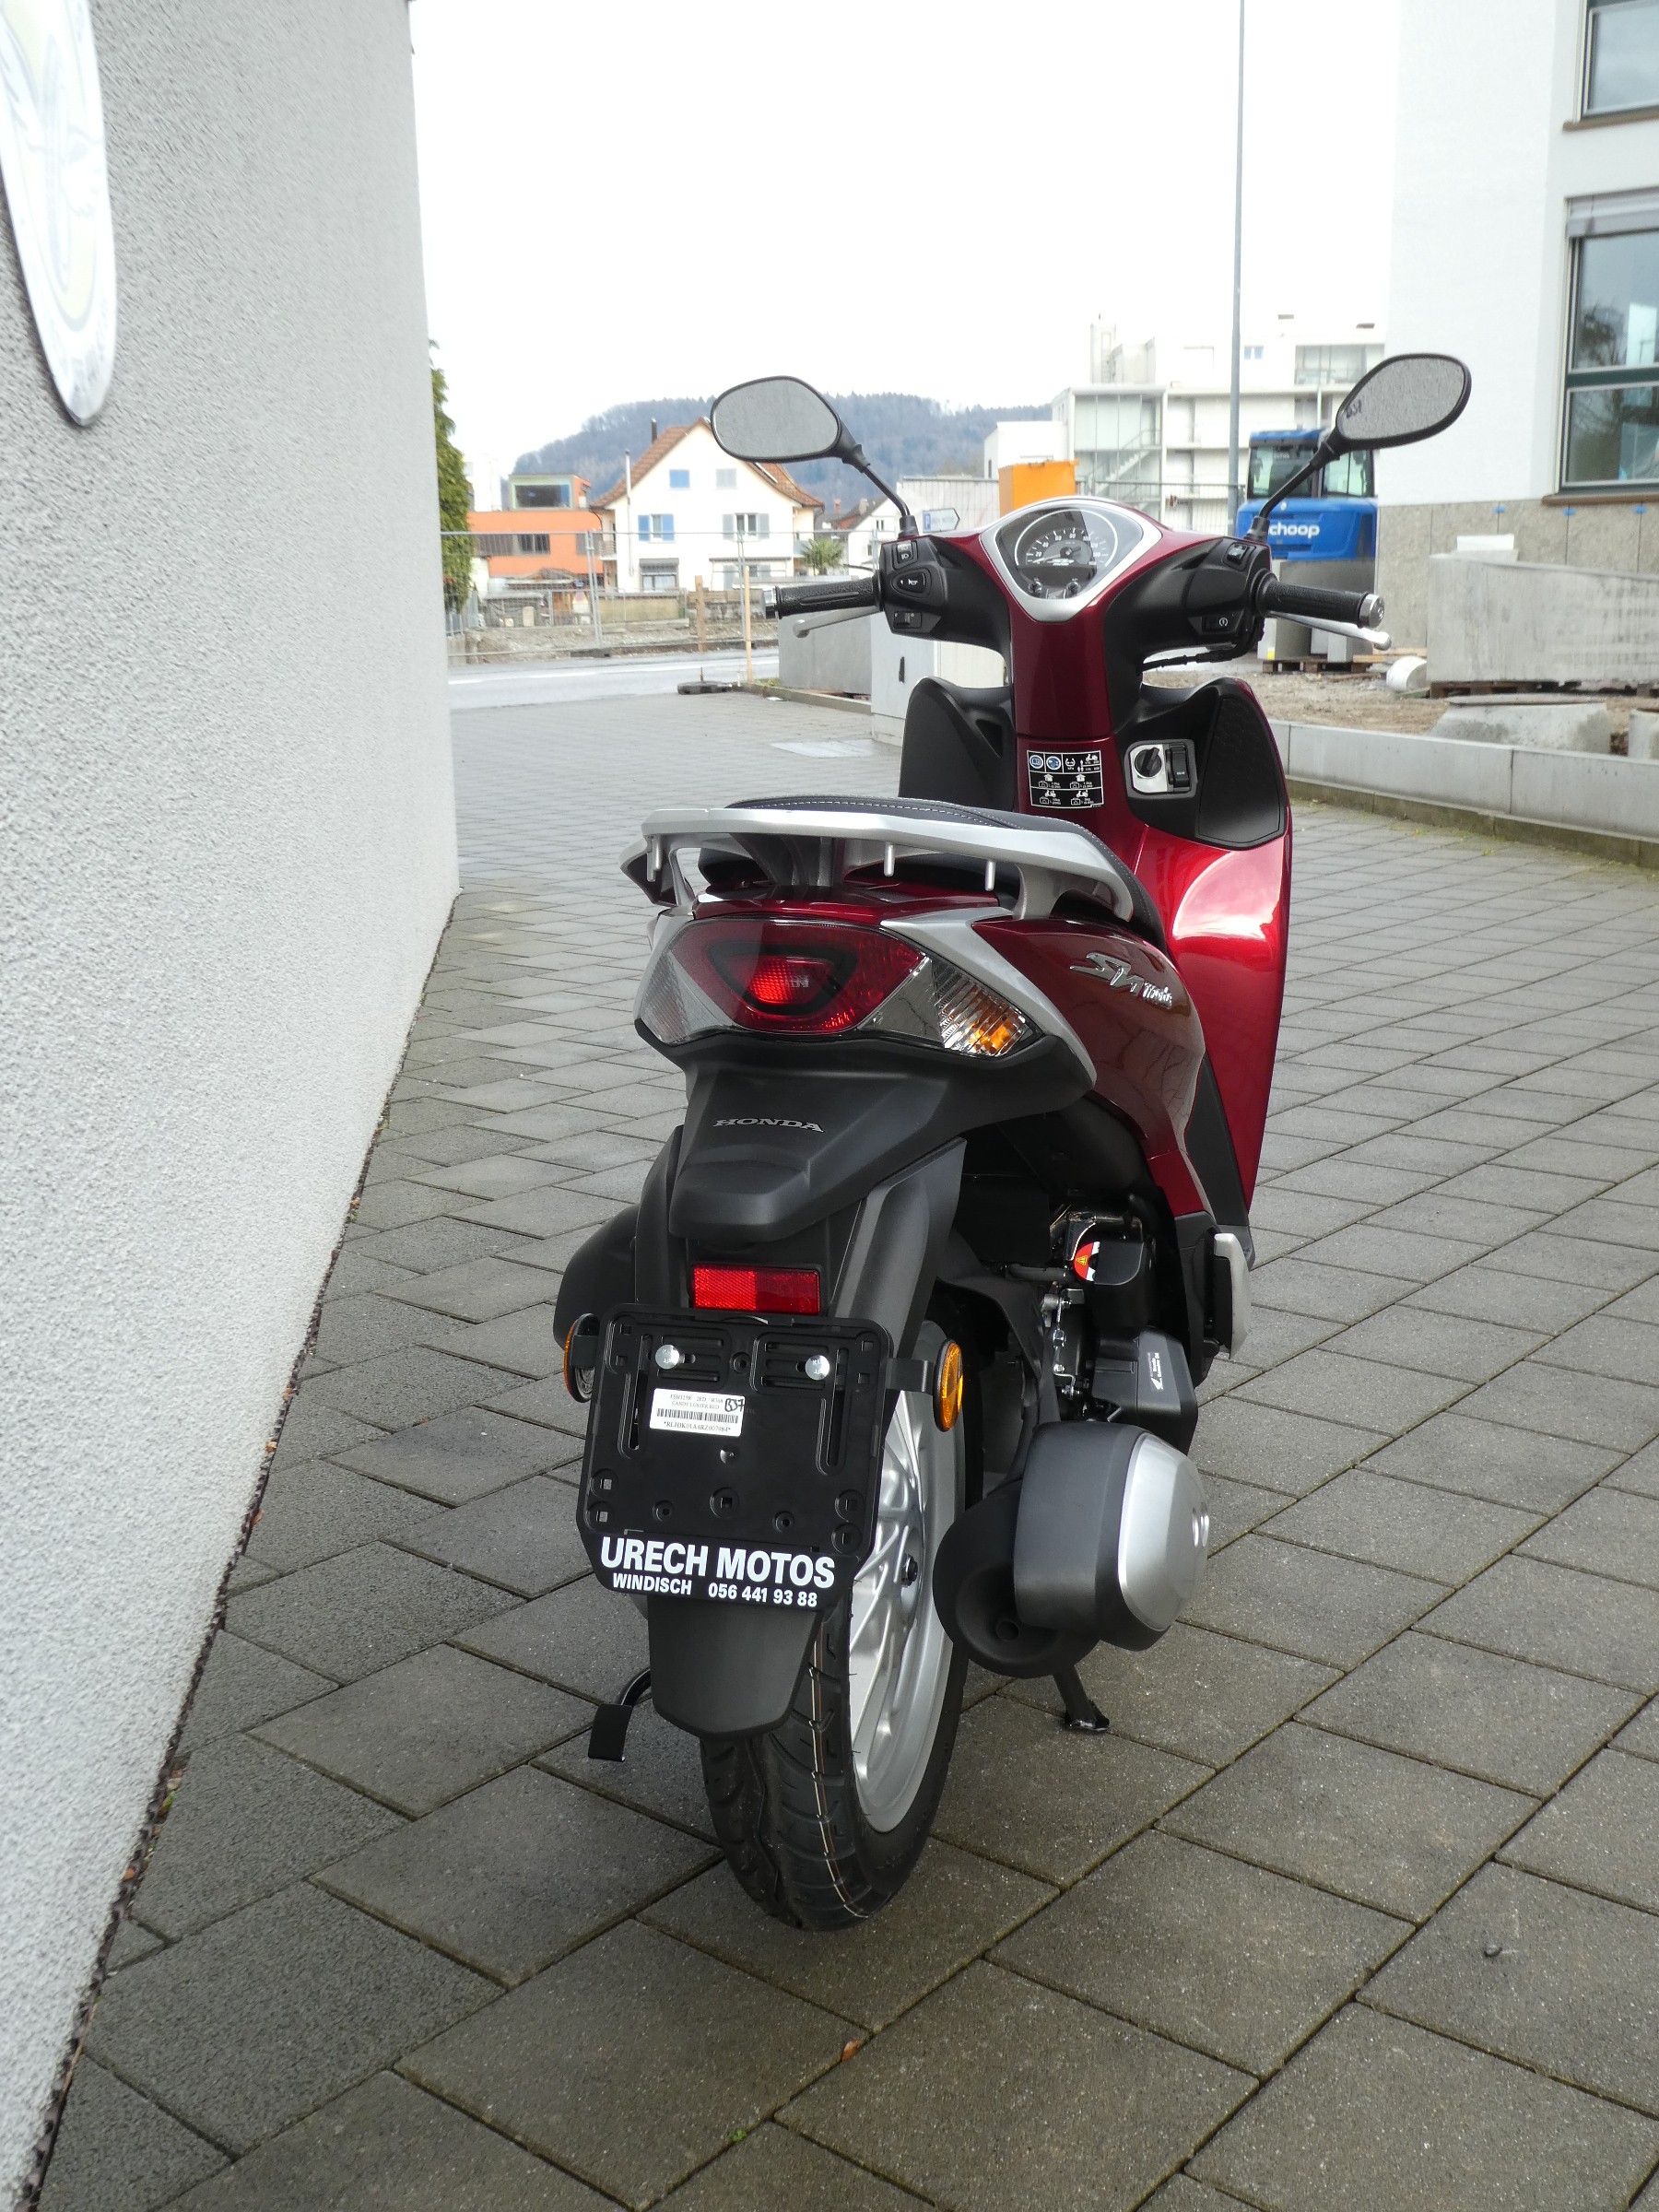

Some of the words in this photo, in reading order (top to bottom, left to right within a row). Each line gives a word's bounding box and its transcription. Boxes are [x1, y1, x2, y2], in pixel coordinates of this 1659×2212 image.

[1268, 522, 1320, 538] choop
[713, 1118, 825, 1133] HONDA
[601, 1535, 709, 1576] URECH
[716, 1547, 835, 1588] MOTOS
[612, 1572, 692, 1595] WINDISCH
[708, 1583, 737, 1600] 056
[742, 1586, 768, 1603] 441
[773, 1589, 793, 1605] 93
[797, 1591, 818, 1607] 88
